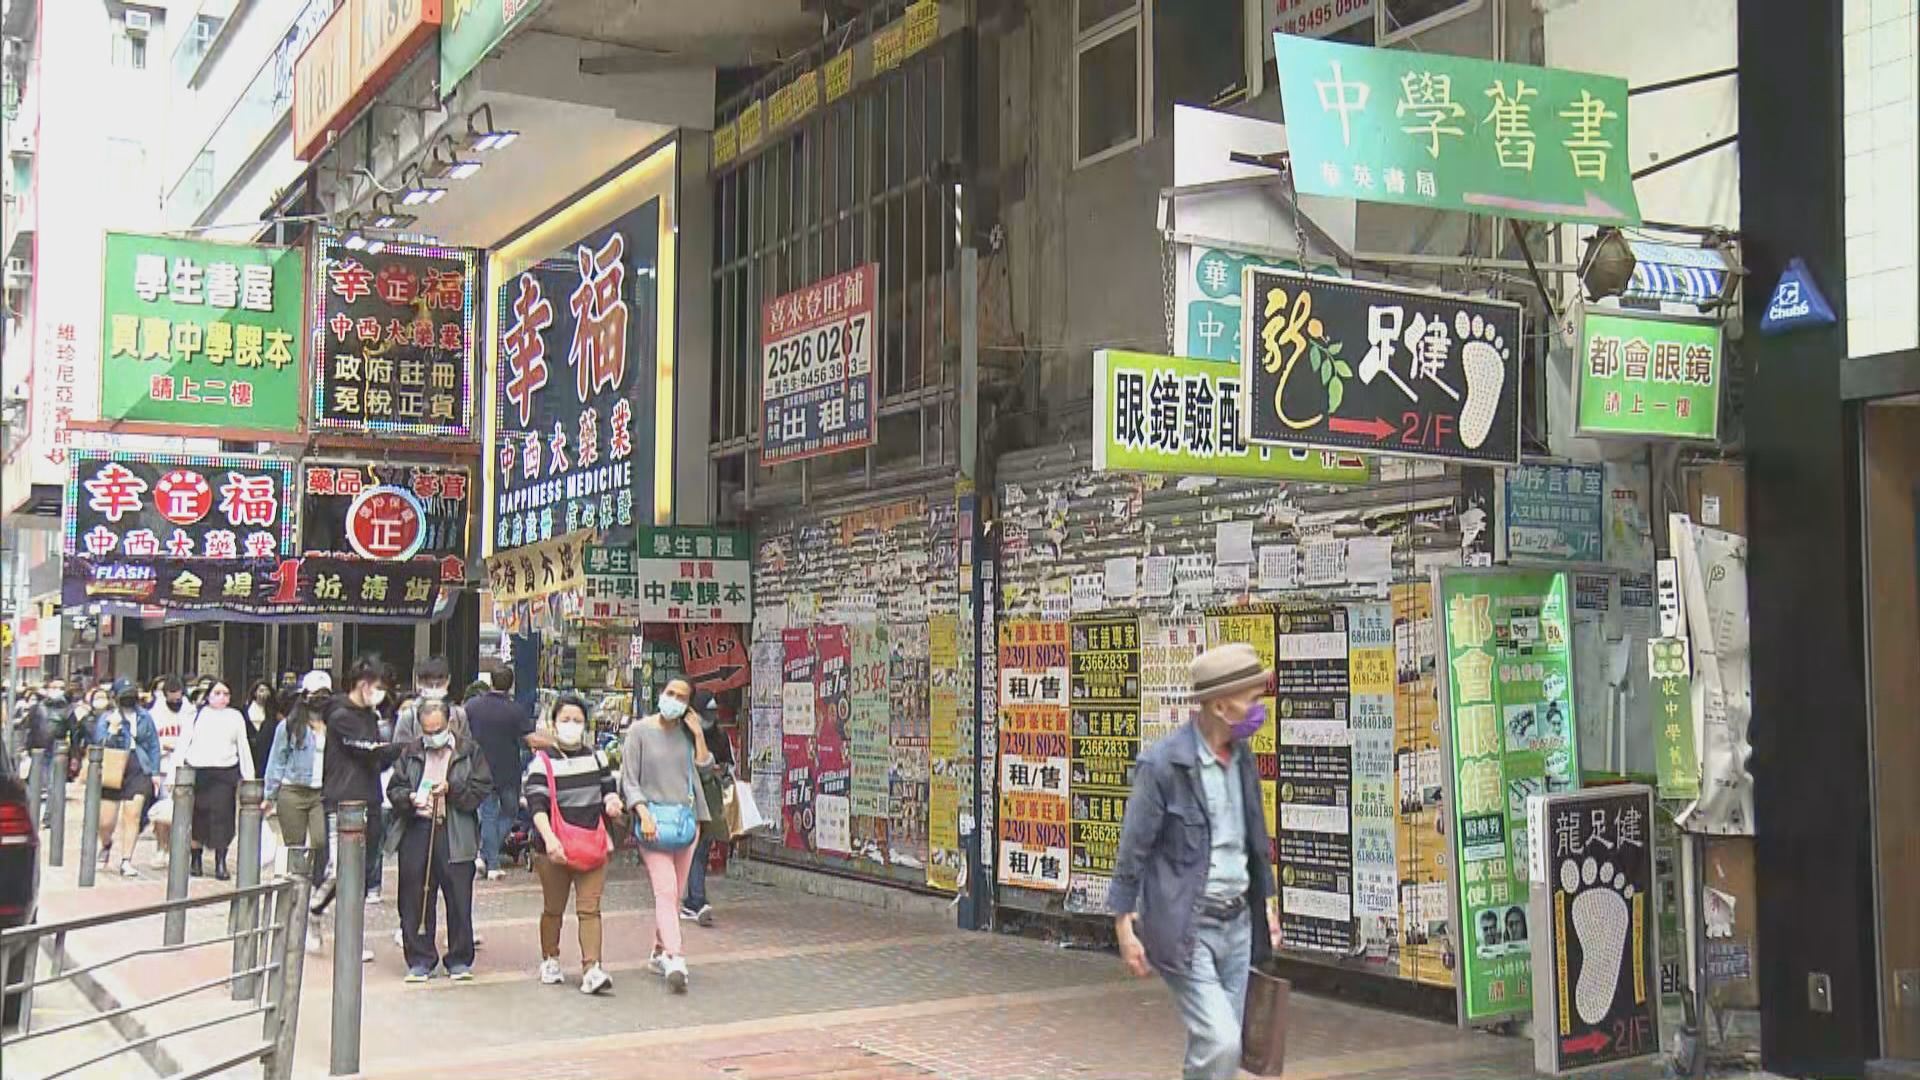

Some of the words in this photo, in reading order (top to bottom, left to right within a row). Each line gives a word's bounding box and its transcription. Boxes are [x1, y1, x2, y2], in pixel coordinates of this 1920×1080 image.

[1313, 58, 1619, 182] 中學舊書
[135, 254, 273, 311] 學生書屋
[334, 354, 456, 388] 政府註冊
[768, 332, 812, 379] 2526
[1590, 336, 1712, 384] 都會眼鏡
[151, 376, 253, 407] 請上二樓
[800, 367, 827, 389] 9456
[333, 386, 456, 420] 免稅正貨
[782, 398, 846, 442] 出租
[1401, 413, 1454, 448] 2/F
[499, 398, 631, 489] 中西大藥業
[499, 475, 562, 515] HAPPINESS
[565, 461, 632, 500] MEDICINE
[96, 565, 152, 580] FLASH
[591, 548, 639, 572] 學生
[644, 580, 745, 606] 中學課本
[1351, 629, 1391, 643] 68440189
[1004, 645, 1031, 669] 2391
[1035, 643, 1066, 668] 8028
[1079, 653, 1130, 672] 23662833
[1352, 715, 1393, 730] 68440189
[1004, 732, 1031, 756] 2391
[1035, 732, 1066, 757] 8028
[1079, 738, 1130, 758] 23662833
[1004, 819, 1031, 843] 2391
[1035, 822, 1066, 848] 8028
[1555, 805, 1644, 857] 龍足健
